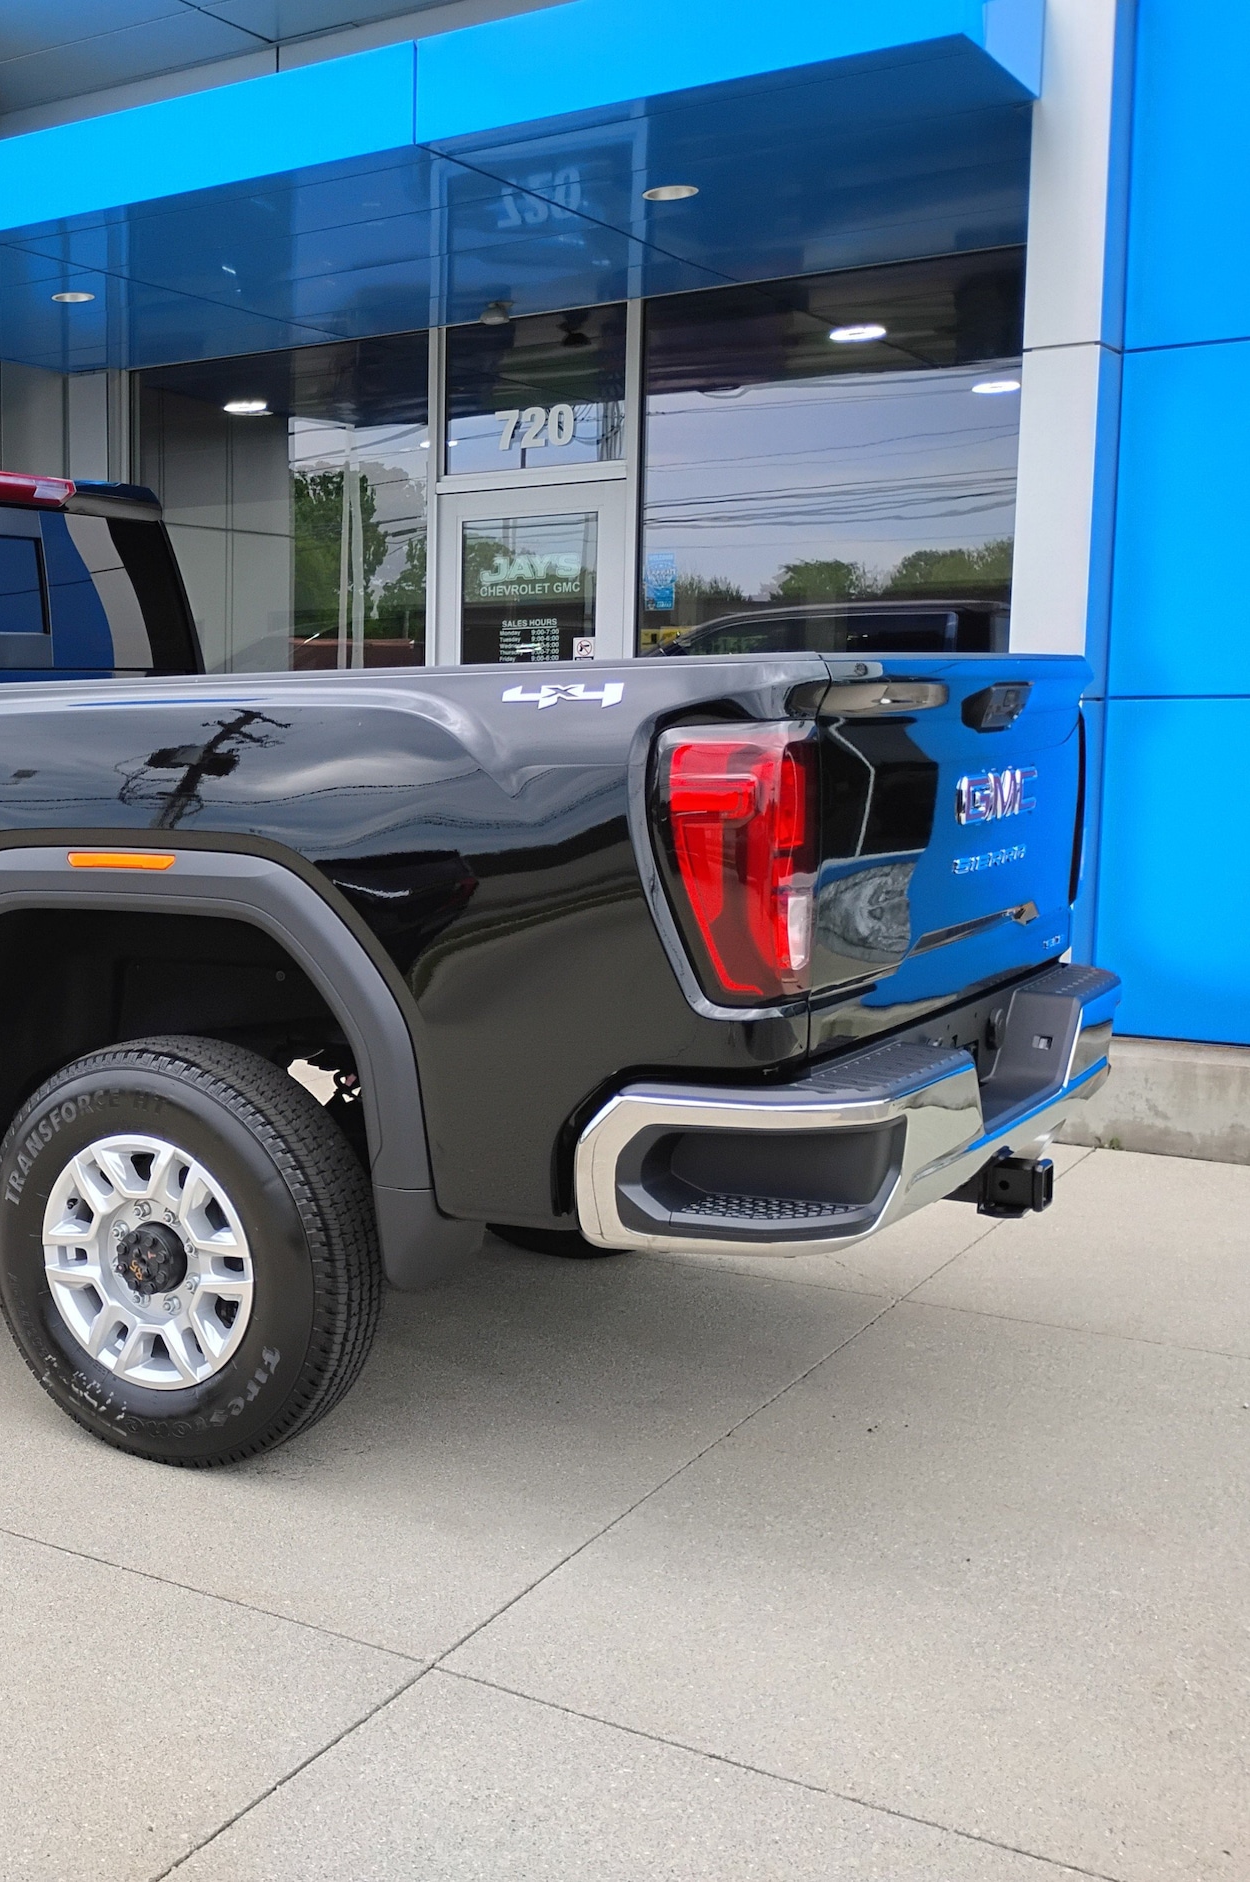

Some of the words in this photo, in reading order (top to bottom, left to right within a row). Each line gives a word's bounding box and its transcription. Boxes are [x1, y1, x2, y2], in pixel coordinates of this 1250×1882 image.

[495, 404, 574, 451] 720
[480, 582, 550, 597] CHEVROLET
[553, 581, 581, 593] GMC
[502, 620, 528, 628] SALES
[529, 618, 558, 627] HOURS
[956, 766, 1038, 825] GMC
[952, 844, 1027, 874] SIERRA
[4, 1089, 121, 1206] TRANSFORCE
